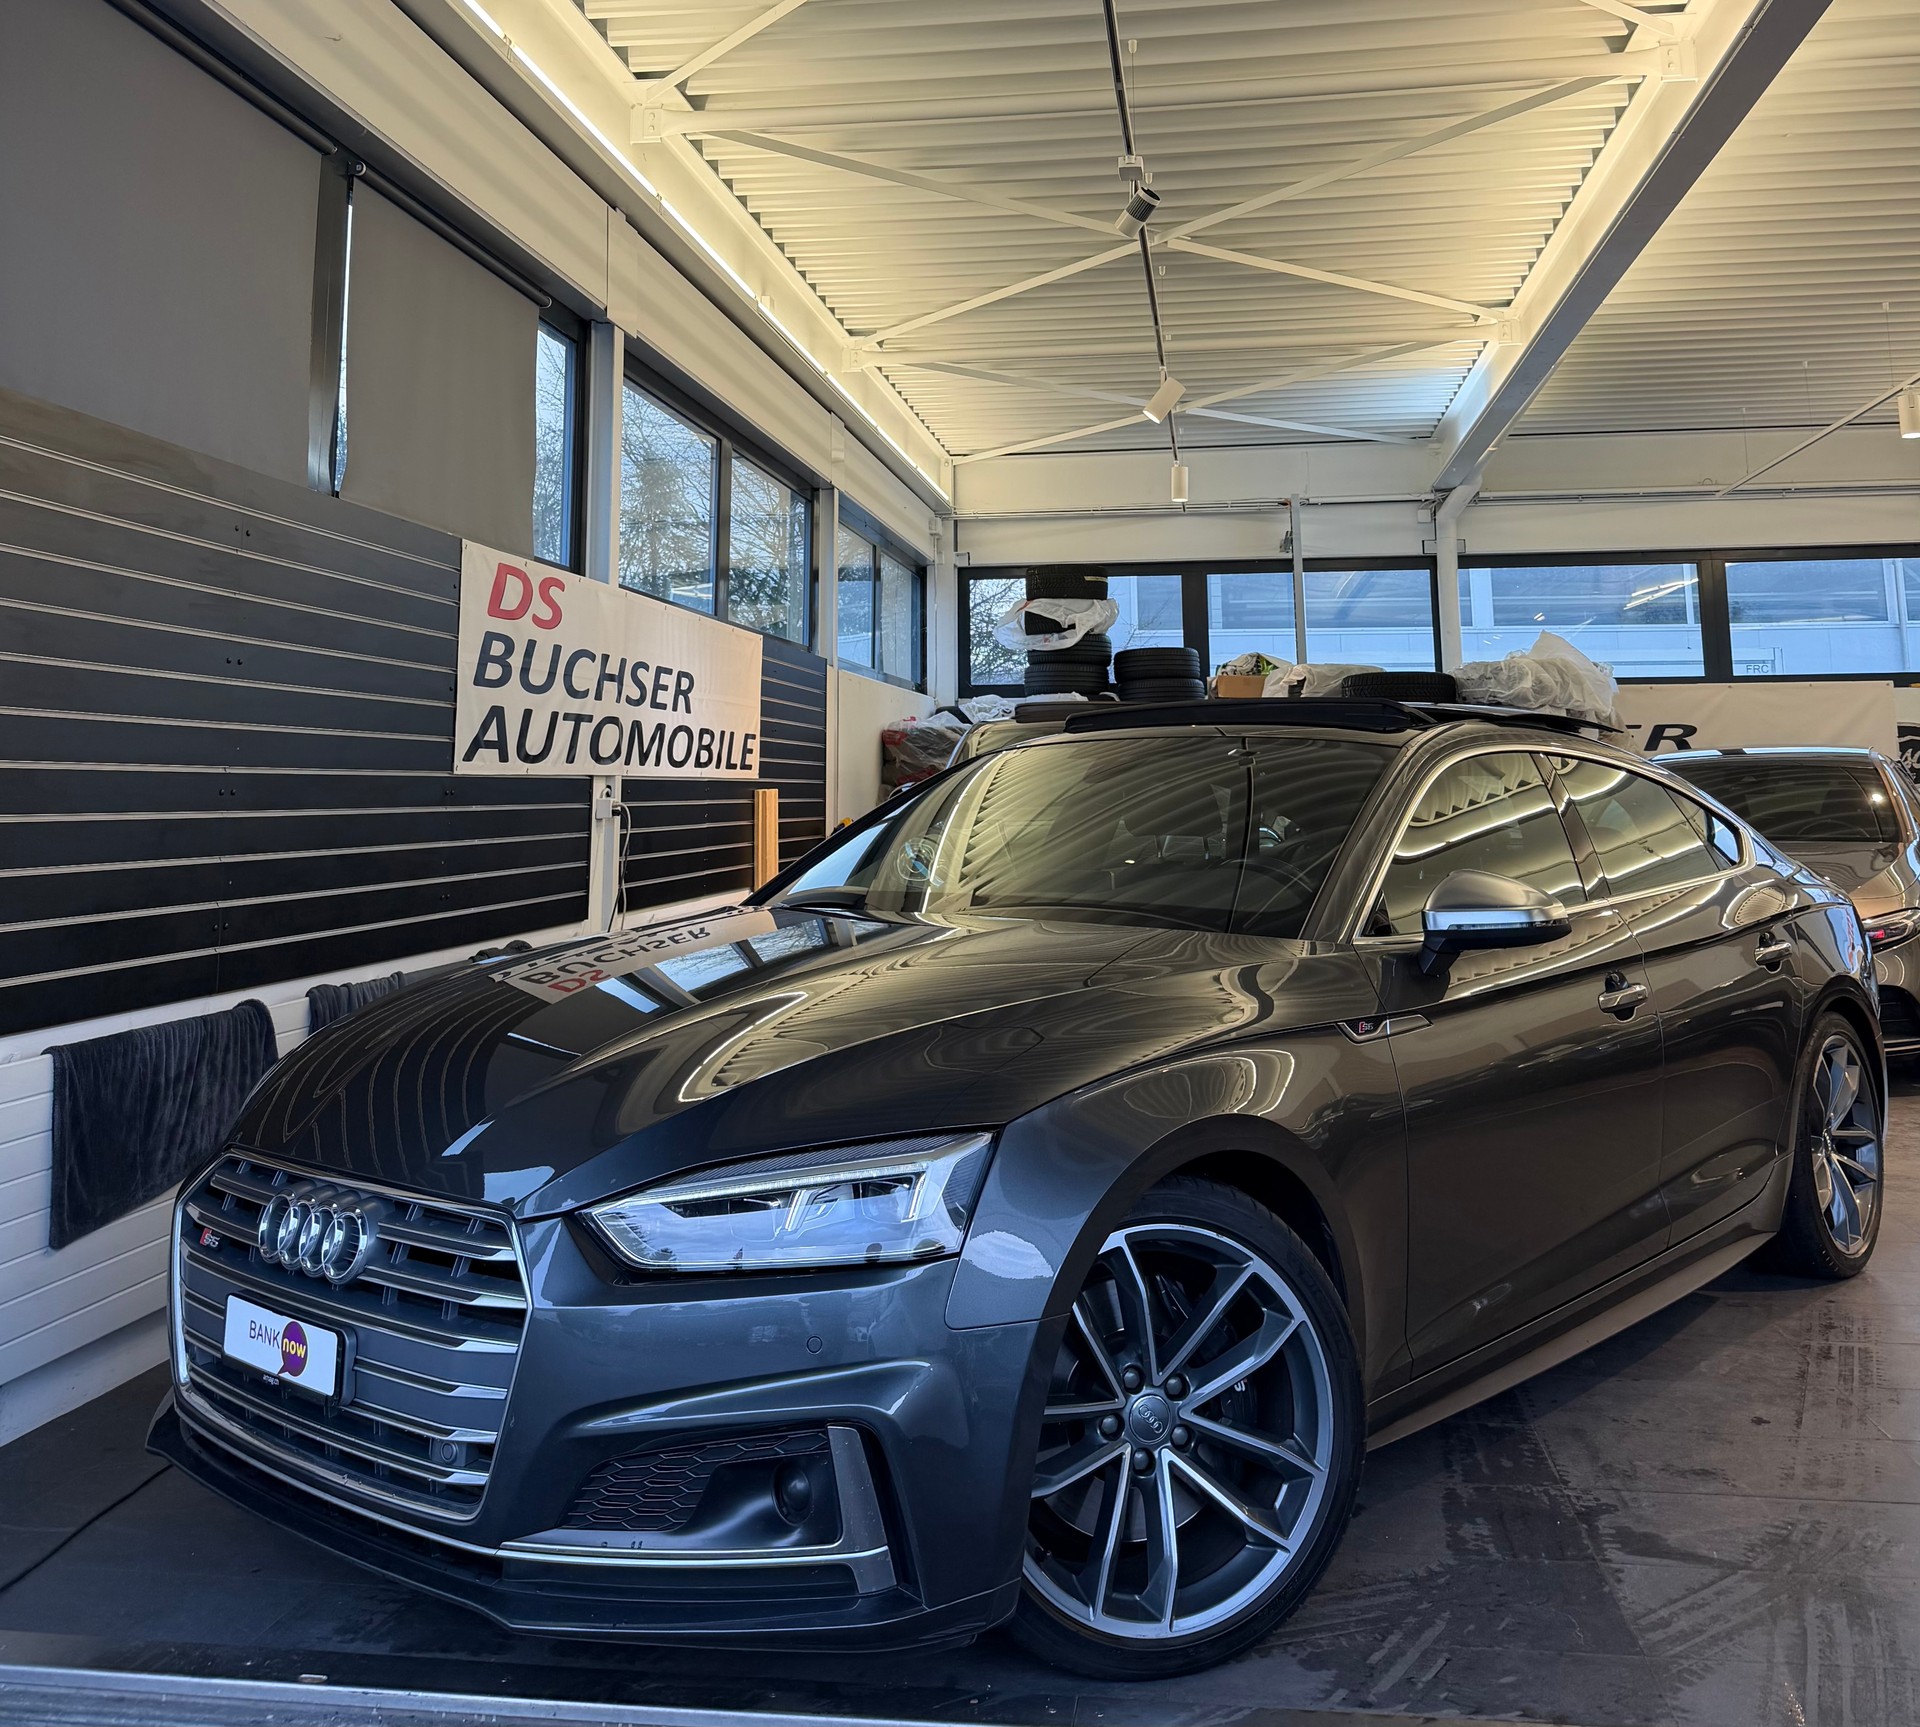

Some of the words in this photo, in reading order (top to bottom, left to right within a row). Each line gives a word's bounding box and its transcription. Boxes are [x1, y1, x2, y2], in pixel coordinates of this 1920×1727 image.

[487, 562, 566, 630] DS
[472, 631, 695, 714] BUCHSER
[1745, 664, 1769, 674] FRC
[462, 705, 757, 771] AUTOMOBILE
[249, 1319, 281, 1350] BANK
[282, 1338, 307, 1359] now
